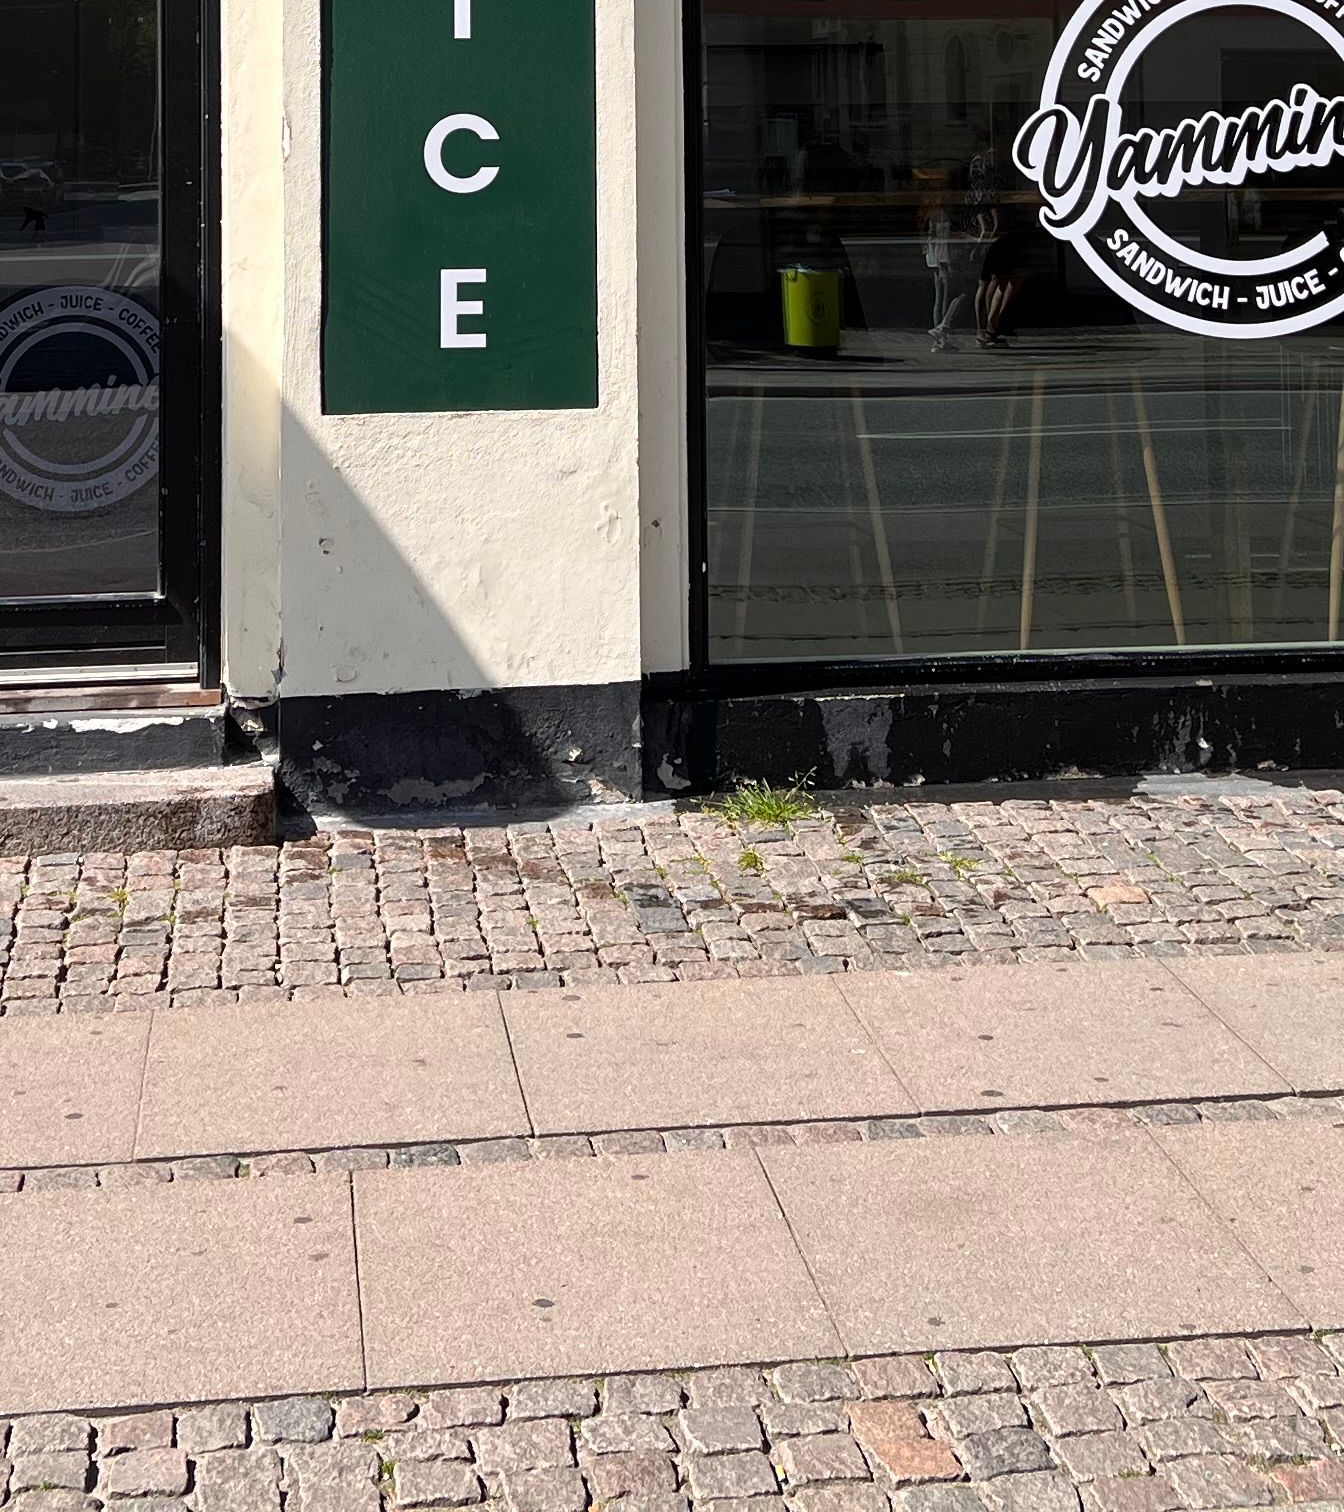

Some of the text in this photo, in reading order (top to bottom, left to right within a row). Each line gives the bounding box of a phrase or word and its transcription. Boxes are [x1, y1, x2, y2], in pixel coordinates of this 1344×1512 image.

[1106, 228, 1230, 310] SANDWICH
[1256, 274, 1323, 310] JUICE
[60, 294, 105, 311] JUICE
[70, 484, 113, 502] JUICE
